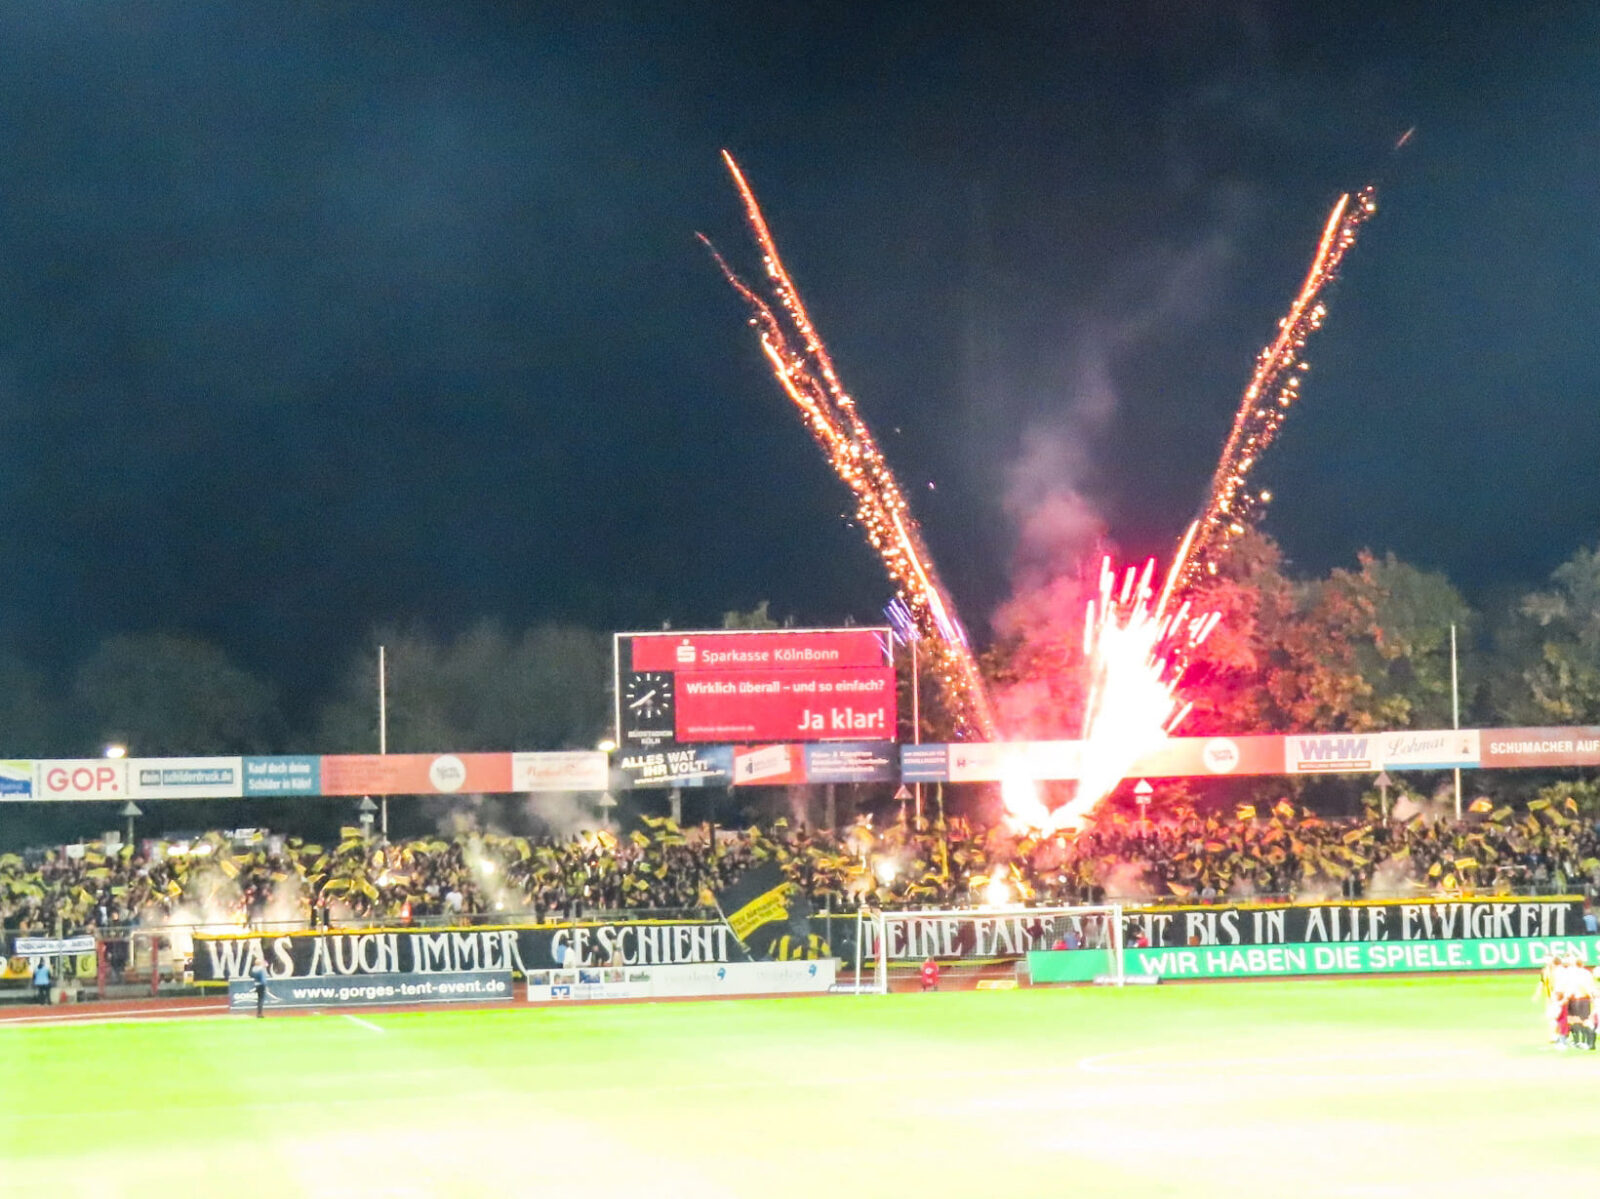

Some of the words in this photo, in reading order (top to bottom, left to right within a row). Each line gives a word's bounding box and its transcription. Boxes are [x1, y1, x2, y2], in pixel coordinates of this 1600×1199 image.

[702, 649, 768, 663] Sparkasse
[774, 647, 838, 661] KölnBonn
[687, 681, 735, 694] Wirklich
[739, 680, 780, 694] überall
[793, 681, 815, 693] und
[819, 683, 833, 692] so
[836, 679, 885, 693] einfach?
[798, 709, 823, 730] Ja
[832, 708, 884, 729] klar!
[1300, 738, 1368, 760] WHM
[1490, 740, 1572, 754] SCHUMACHER
[622, 753, 664, 769] ALLES
[667, 749, 696, 763] WAT
[643, 763, 668, 777] IHR
[47, 767, 119, 792] GOP.
[207, 937, 295, 979] WAS
[310, 933, 401, 976] AUCH
[411, 930, 526, 976] IMMER
[1186, 910, 1241, 945] BIS
[1252, 909, 1288, 944] IN
[1305, 906, 1390, 943] ALLE
[1401, 903, 1572, 941] EWIGKEIT
[1139, 952, 1199, 974] WIR
[1207, 947, 1306, 973] HABEN
[1315, 946, 1362, 969] DIE
[1369, 943, 1472, 968] SPIELE.
[1480, 943, 1520, 966] DU
[1529, 940, 1588, 964] DEN
[293, 979, 506, 1001] www.gorges-tent-event.de
